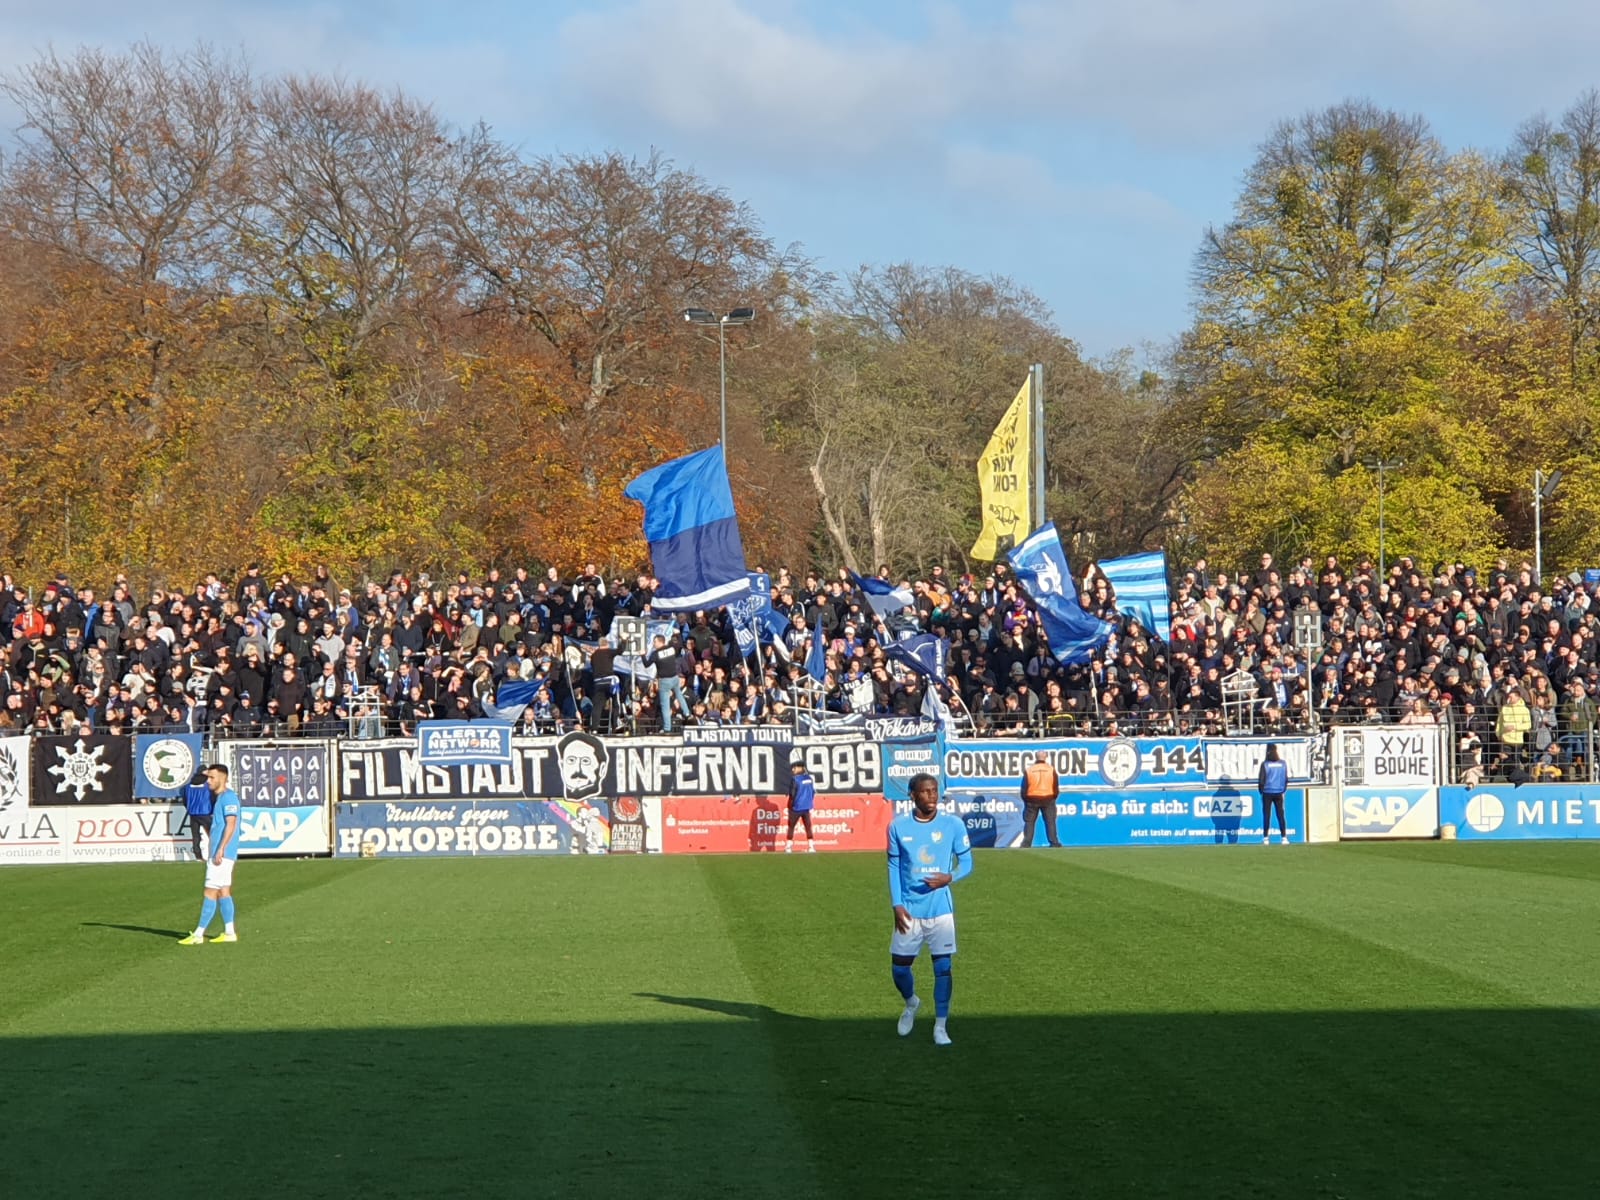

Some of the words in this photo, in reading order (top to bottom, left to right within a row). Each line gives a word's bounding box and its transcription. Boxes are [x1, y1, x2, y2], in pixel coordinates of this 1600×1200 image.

[431, 729, 500, 739] ALERTA
[683, 728, 748, 743] FILMSTADT
[751, 728, 792, 743] YOUTH
[616, 746, 775, 793] INFERNO
[946, 749, 1088, 777] CONNECION
[756, 808, 780, 820] Das
[960, 799, 1018, 814] werden.
[1082, 800, 1117, 818] Liga
[1122, 799, 1147, 815] für
[1151, 799, 1189, 815] sich:
[1344, 796, 1409, 827] SAP
[461, 808, 510, 826] gegen
[967, 818, 993, 829] SVB!
[240, 812, 299, 842] SAP
[1174, 828, 1187, 837] auf
[339, 825, 559, 853] HOMOPHOBIE
